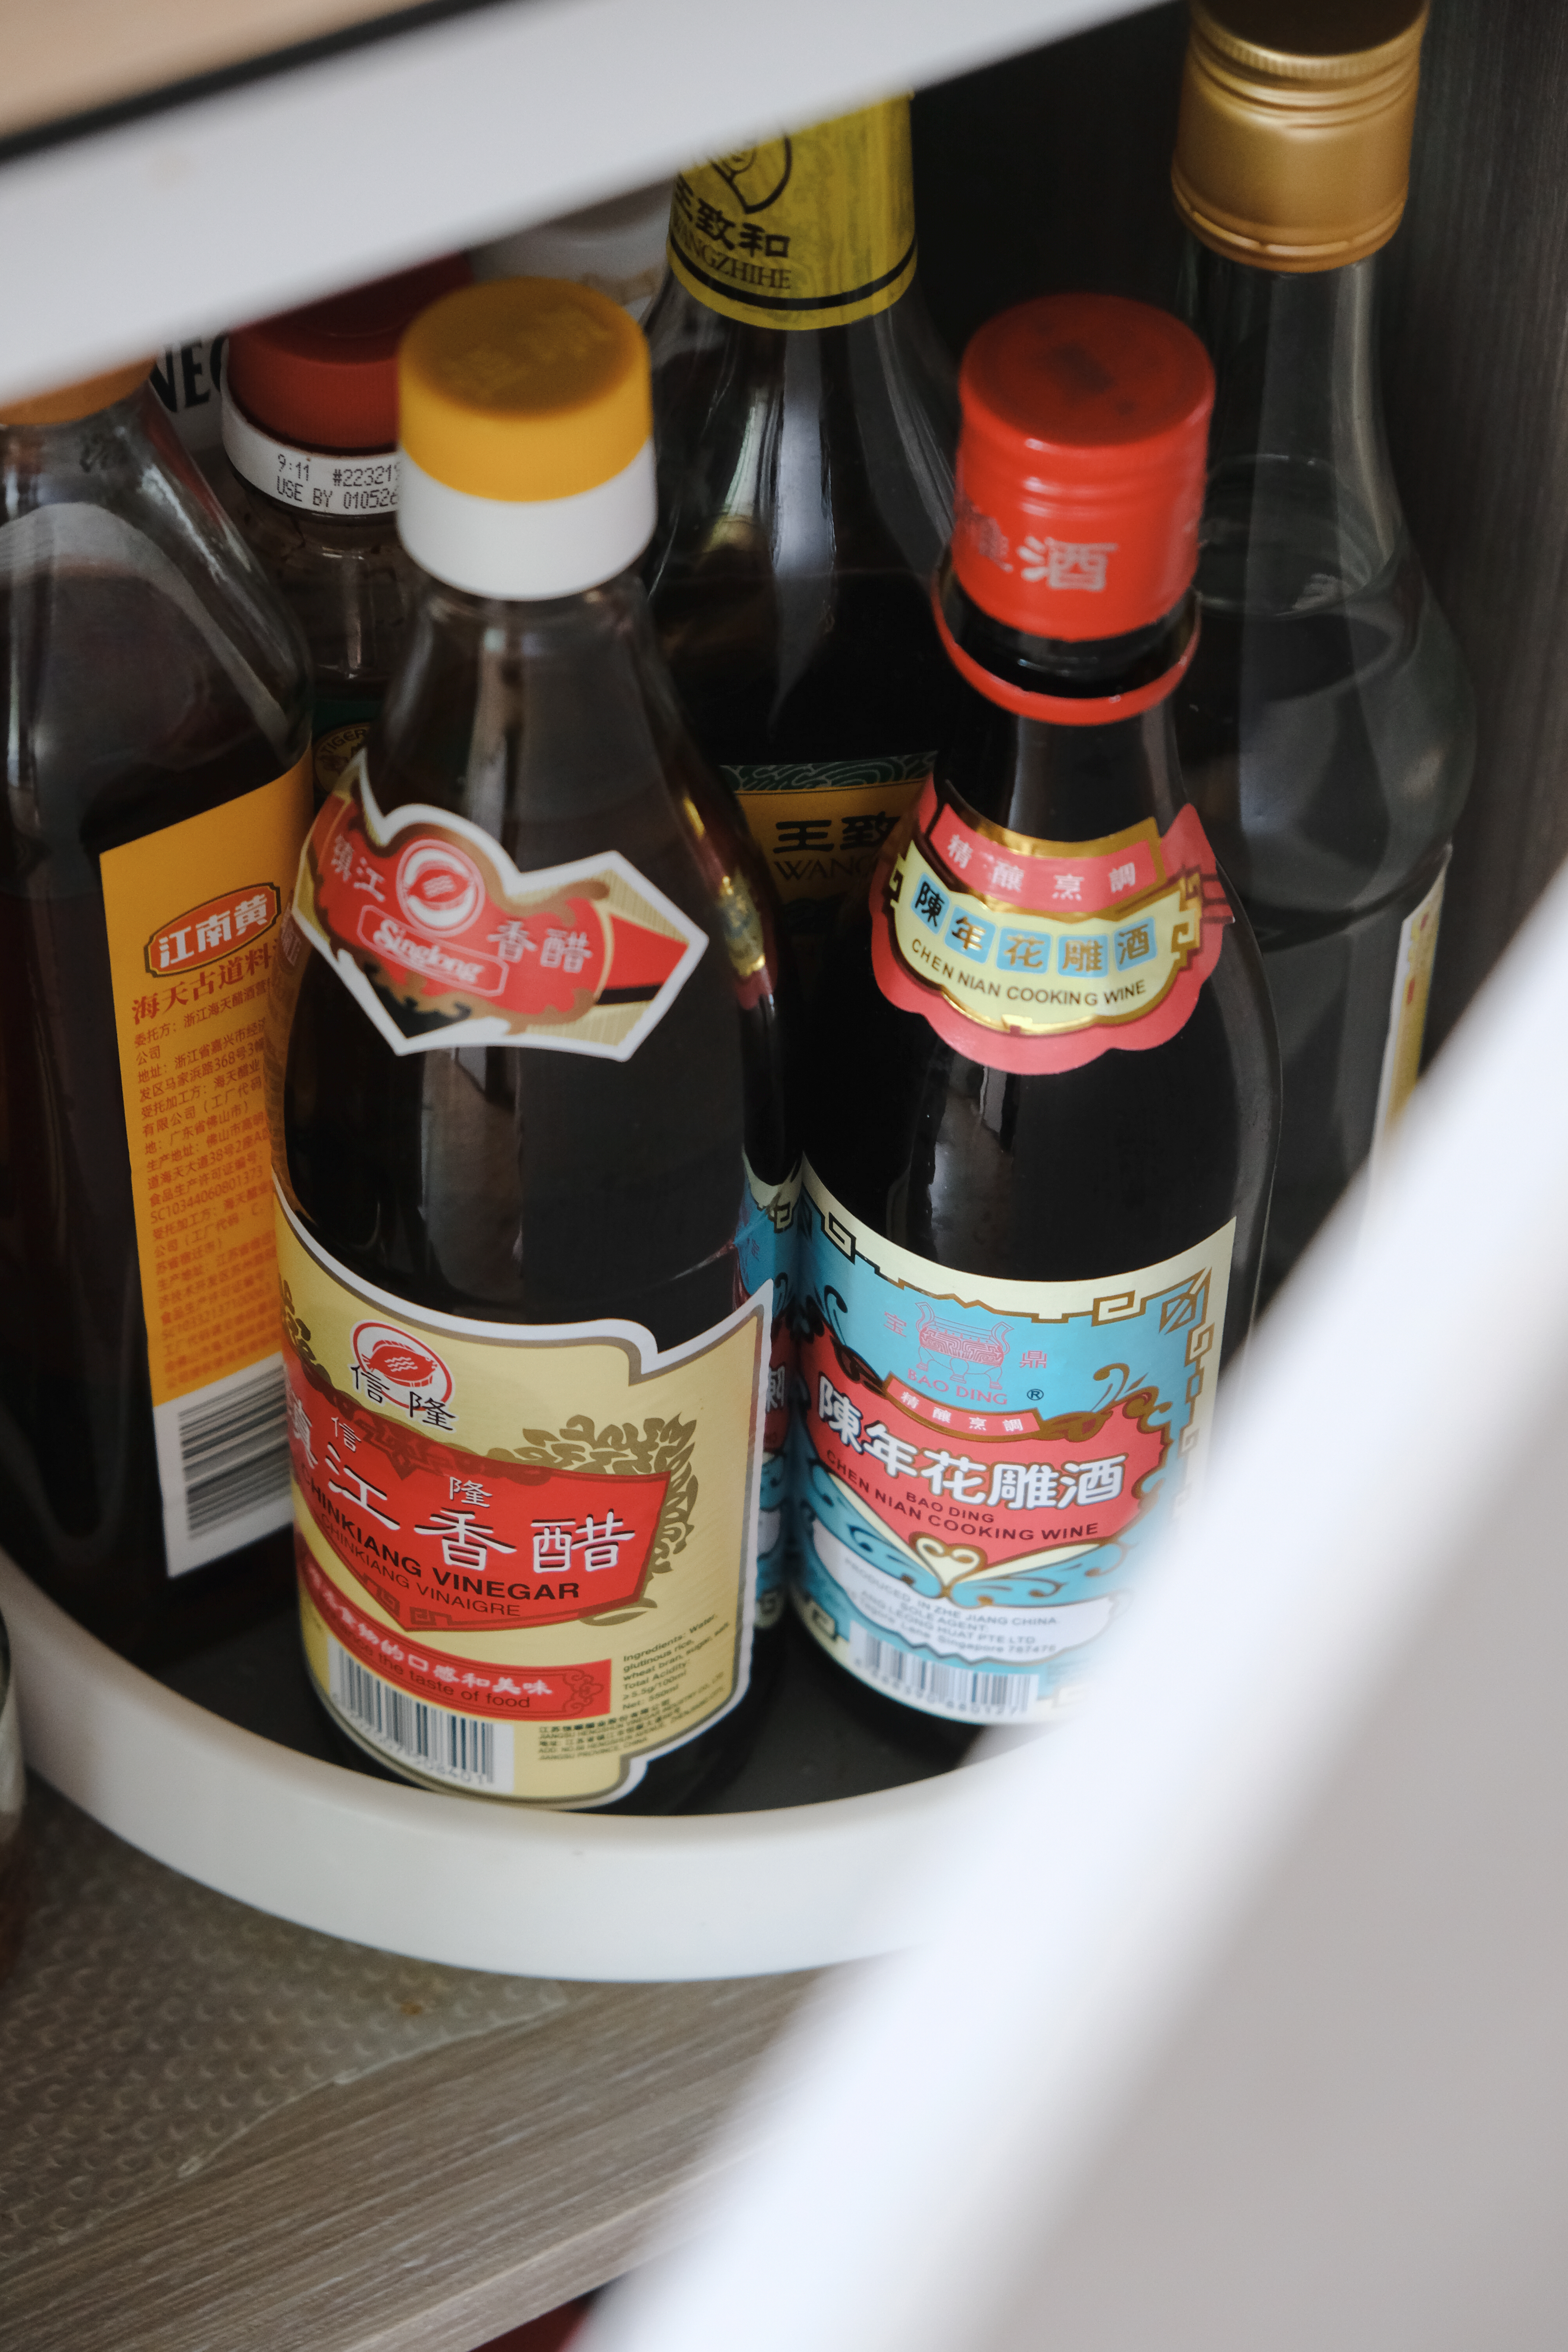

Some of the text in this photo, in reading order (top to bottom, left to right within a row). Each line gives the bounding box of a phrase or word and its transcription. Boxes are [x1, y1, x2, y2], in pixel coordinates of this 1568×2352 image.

[277, 475, 303, 502] USE
[313, 488, 333, 508] BY
[320, 728, 367, 754] TIGER
[159, 894, 268, 968] 江南黄
[487, 920, 593, 975] 香醋
[915, 880, 1151, 973] 陳年花雕酒
[132, 942, 276, 1024] 海天古道料
[911, 938, 1147, 1006] CHEN NIAN COOKING WINE
[1019, 1350, 1048, 1369] 鼎
[350, 1365, 456, 1431] 信隆
[907, 1368, 1008, 1406] BAO DING
[818, 1374, 1127, 1510] 陳年花雕酒
[826, 1449, 1099, 1541] CHEN NIAN COOKING WINE
[906, 1491, 995, 1523] BAO DING
[321, 1513, 521, 1617] CHINKIANG VINAIGRE
[432, 1567, 579, 1601] VINEGAR
[965, 1613, 1008, 1626] JIANG
[1011, 1616, 1058, 1626] CHINA
[379, 1652, 530, 1709] the taste of food
[622, 1665, 655, 1681] wheat
[622, 1677, 649, 1690] Total
[623, 1650, 672, 1673] glutinous
